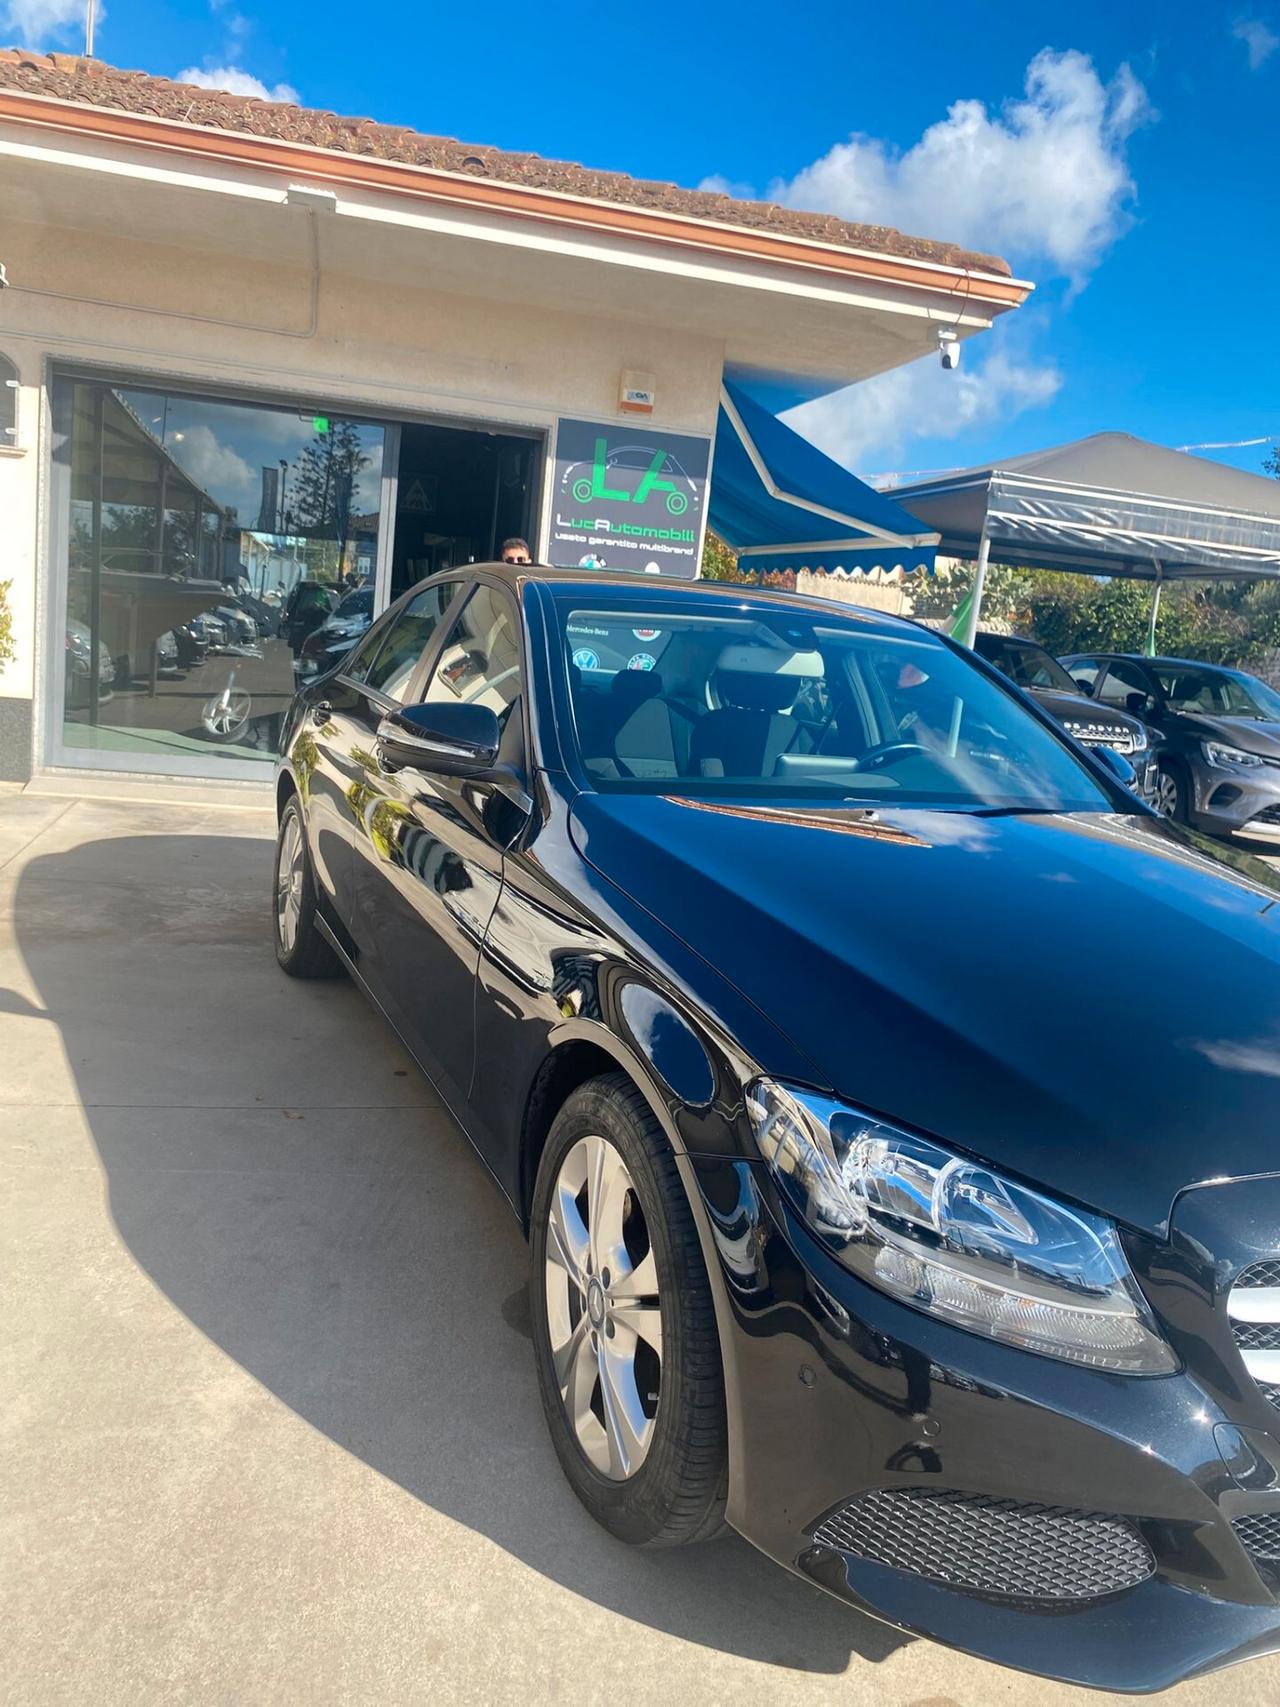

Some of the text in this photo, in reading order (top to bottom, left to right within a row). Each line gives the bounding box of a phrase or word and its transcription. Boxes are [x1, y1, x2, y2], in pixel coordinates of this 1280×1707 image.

[556, 513, 695, 542] LucAutomobili
[555, 532, 694, 555] usato garantito multibrand
[1088, 723, 1130, 734] ROVER
